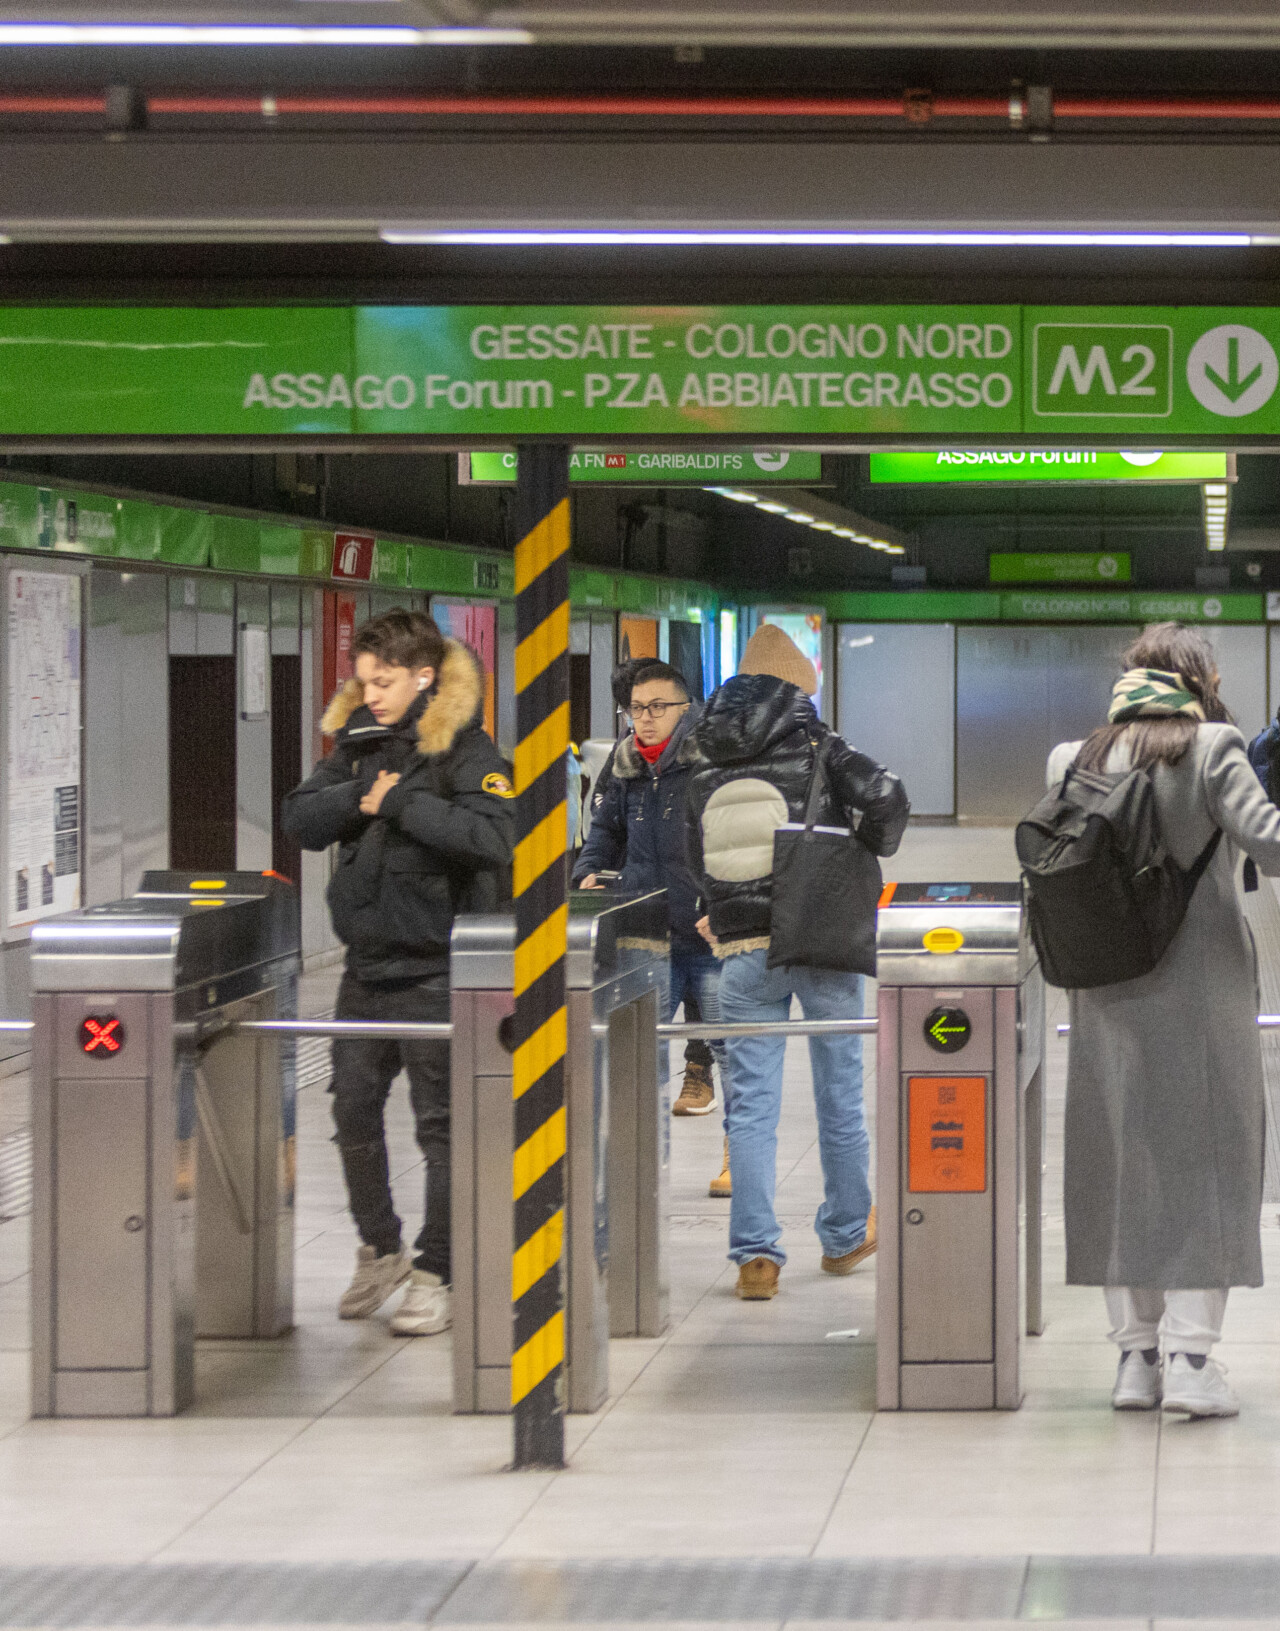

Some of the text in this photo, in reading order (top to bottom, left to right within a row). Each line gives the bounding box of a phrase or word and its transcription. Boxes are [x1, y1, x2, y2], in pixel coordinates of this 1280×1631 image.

[470, 323, 1013, 360] GESSATE - COLOGNO NORD
[1047, 343, 1157, 396] M2
[243, 373, 416, 409] ASSAGO
[424, 373, 554, 409] Forum
[560, 390, 575, 398] -
[679, 373, 1013, 409] ABBIATEGRASSO
[584, 454, 605, 468] FN
[606, 456, 625, 466] M1
[638, 454, 719, 469] GARIBALDI
[723, 455, 743, 469] FS
[936, 450, 1097, 464] ASSAGO Forum
